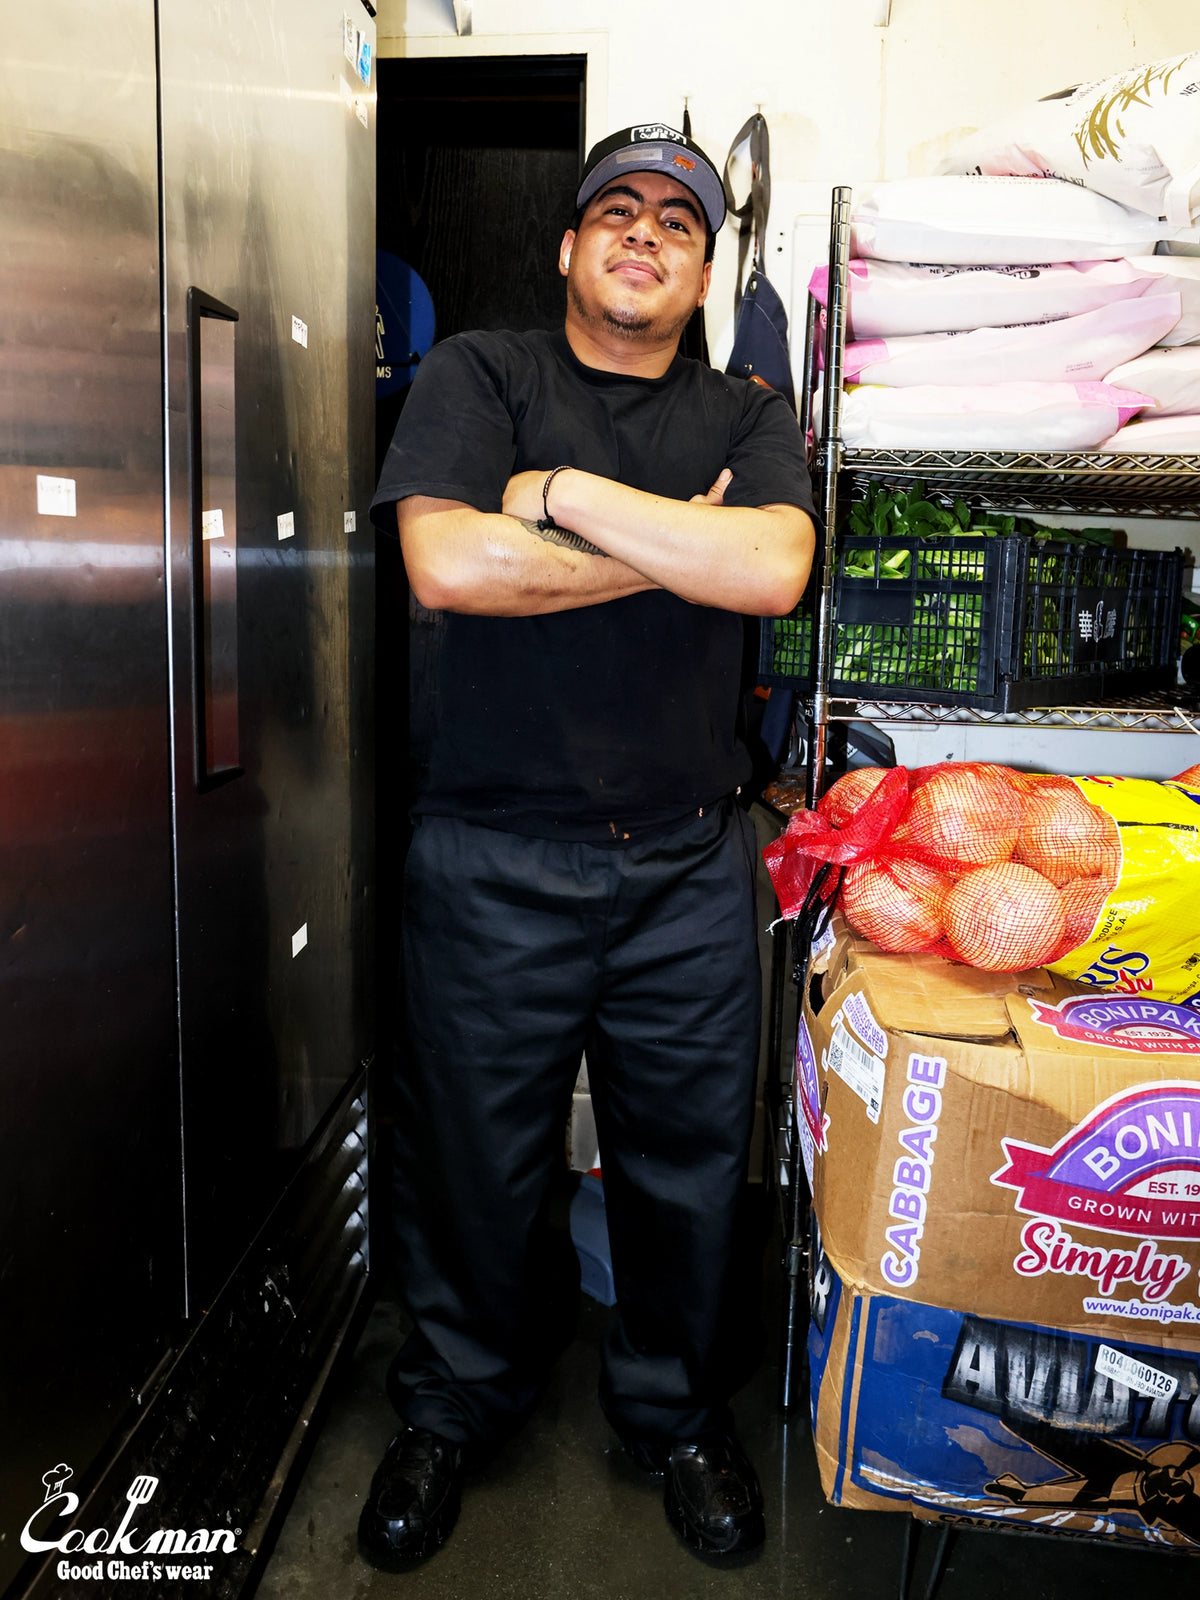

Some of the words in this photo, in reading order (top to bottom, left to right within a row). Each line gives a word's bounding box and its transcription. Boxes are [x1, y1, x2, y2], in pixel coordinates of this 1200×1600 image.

[1079, 1005, 1200, 1036] BONIPAK
[1085, 1031, 1139, 1048] GROWN
[1143, 1042, 1183, 1050] WITH
[884, 1058, 941, 1283] CABBAGE
[1148, 1181, 1179, 1195] EST.
[1068, 1196, 1152, 1223] GROWN
[1016, 1221, 1186, 1300] Simply
